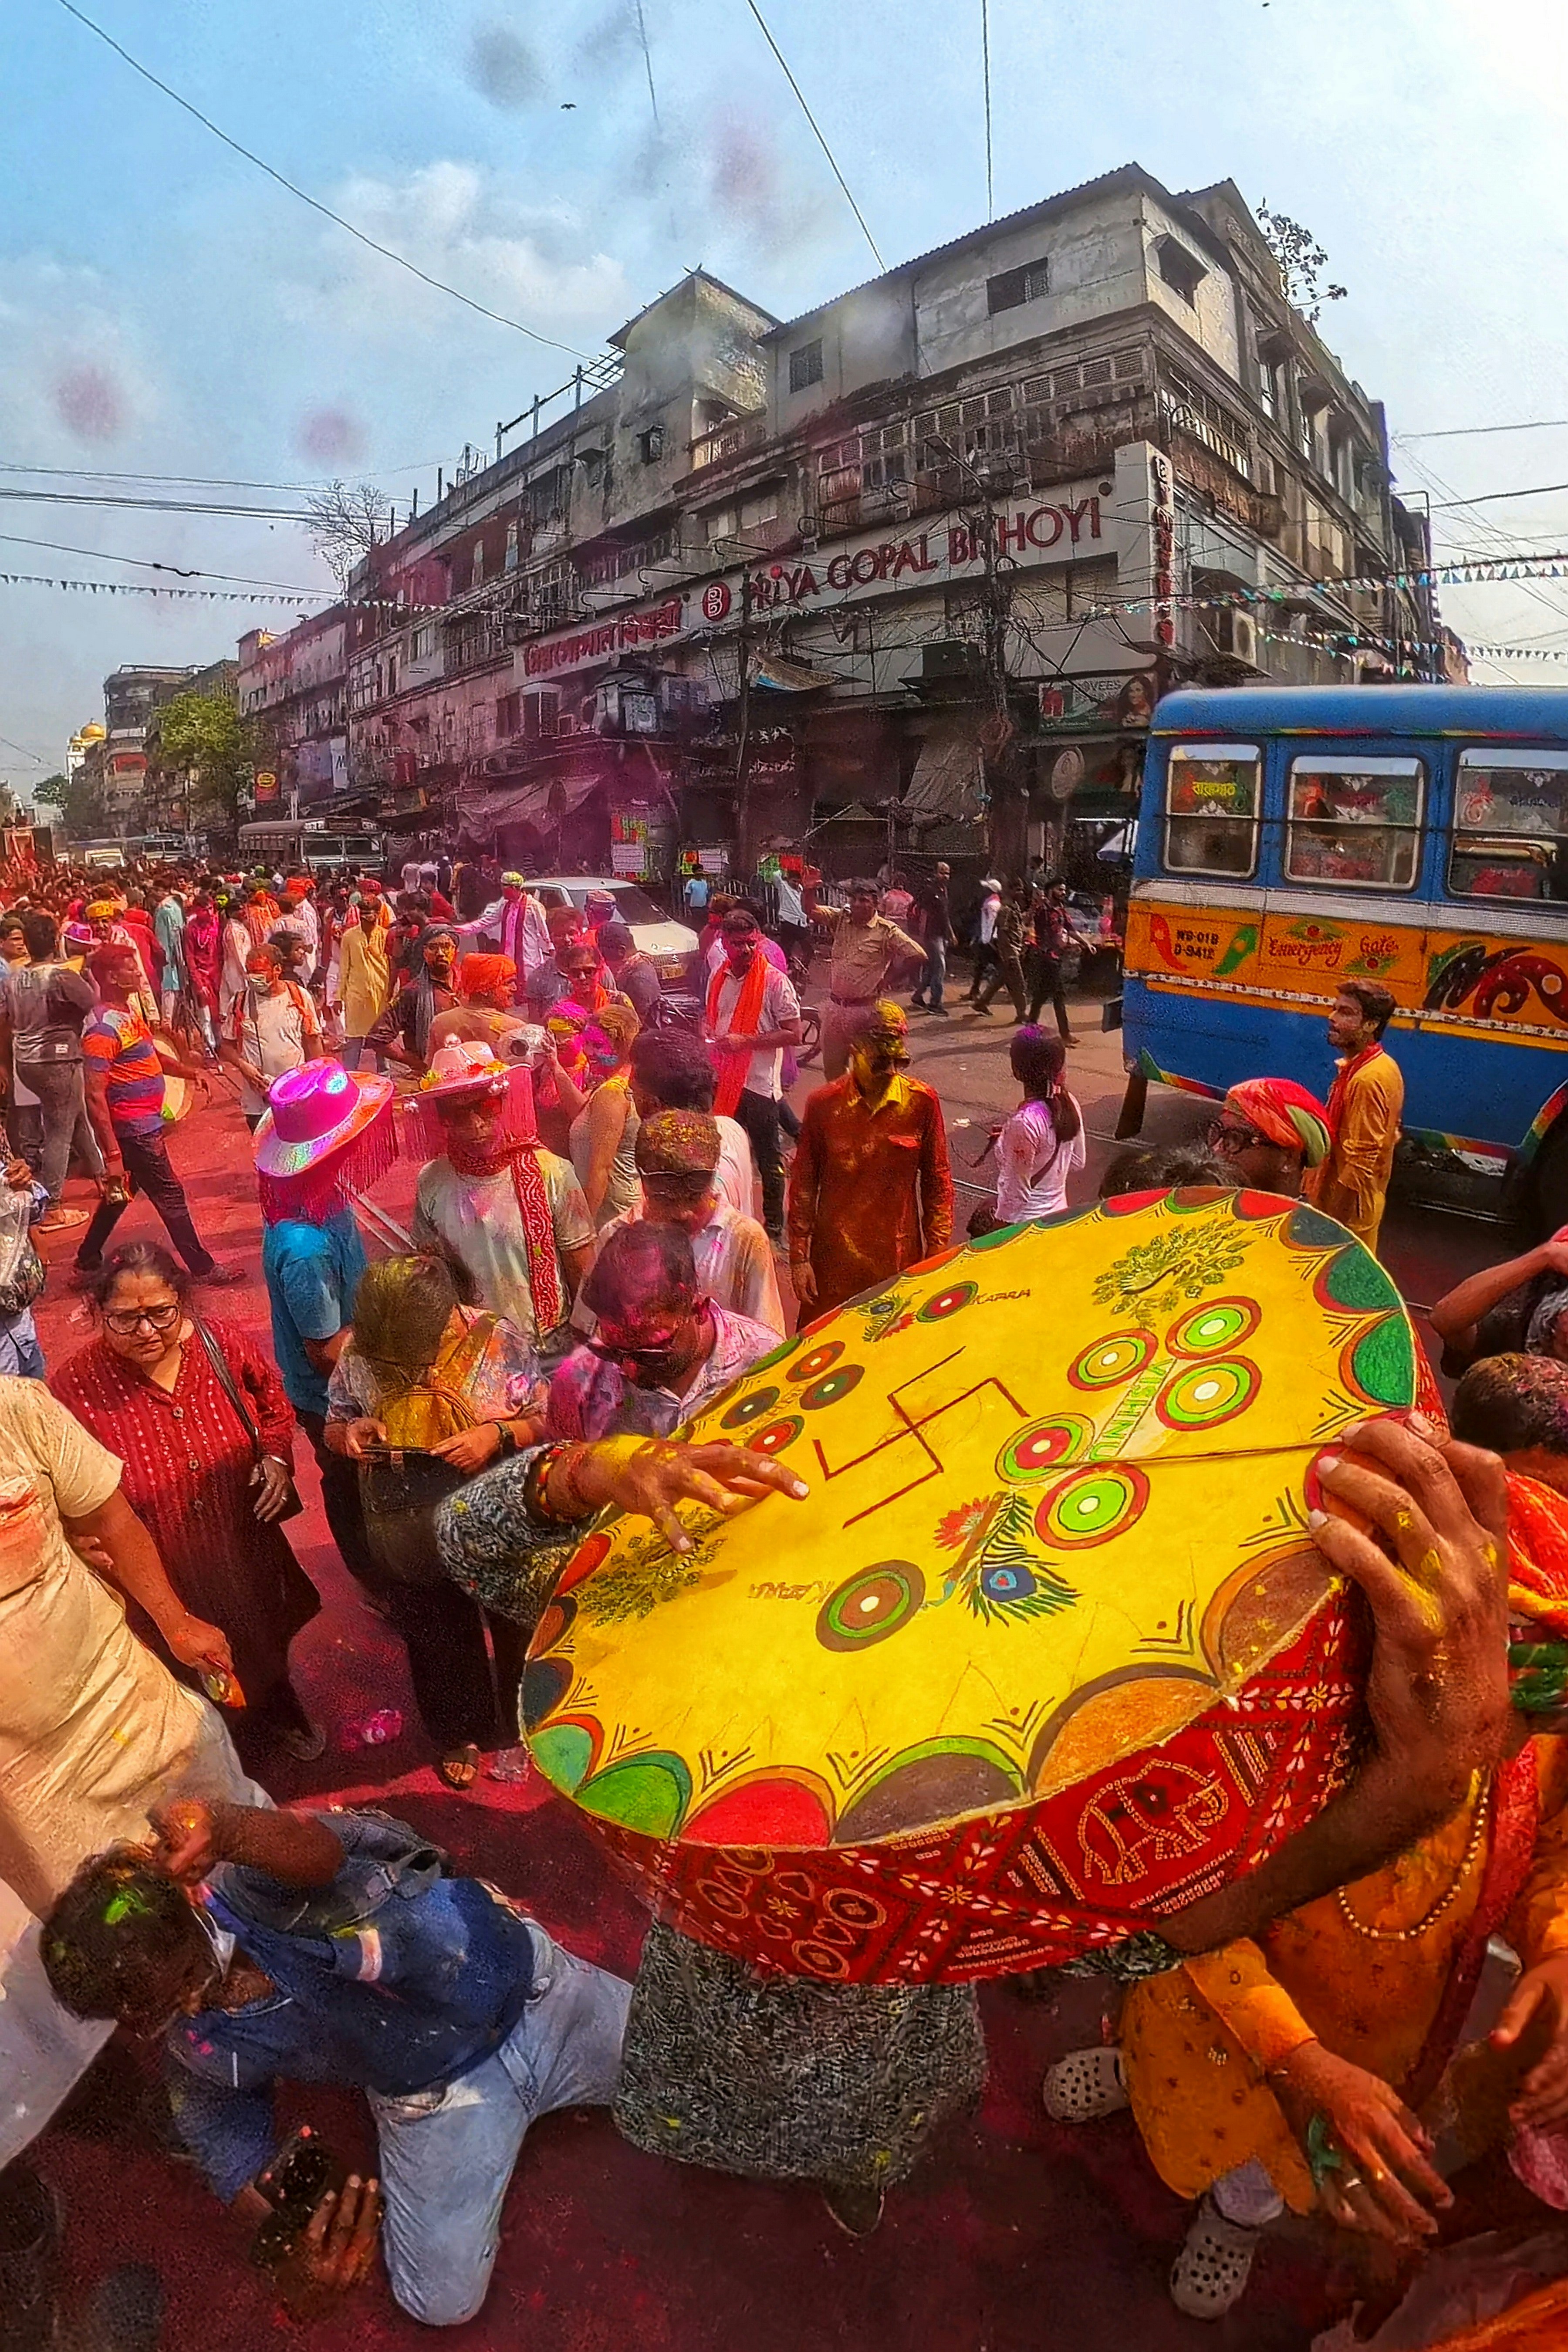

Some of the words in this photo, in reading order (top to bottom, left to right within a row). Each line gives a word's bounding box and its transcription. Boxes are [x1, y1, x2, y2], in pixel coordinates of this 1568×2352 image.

[827, 533, 939, 590] GOPAL
[948, 497, 1102, 565] BIHOYI
[1269, 936, 1342, 967] Emergency
[1089, 1357, 1173, 1460] VISHNU
